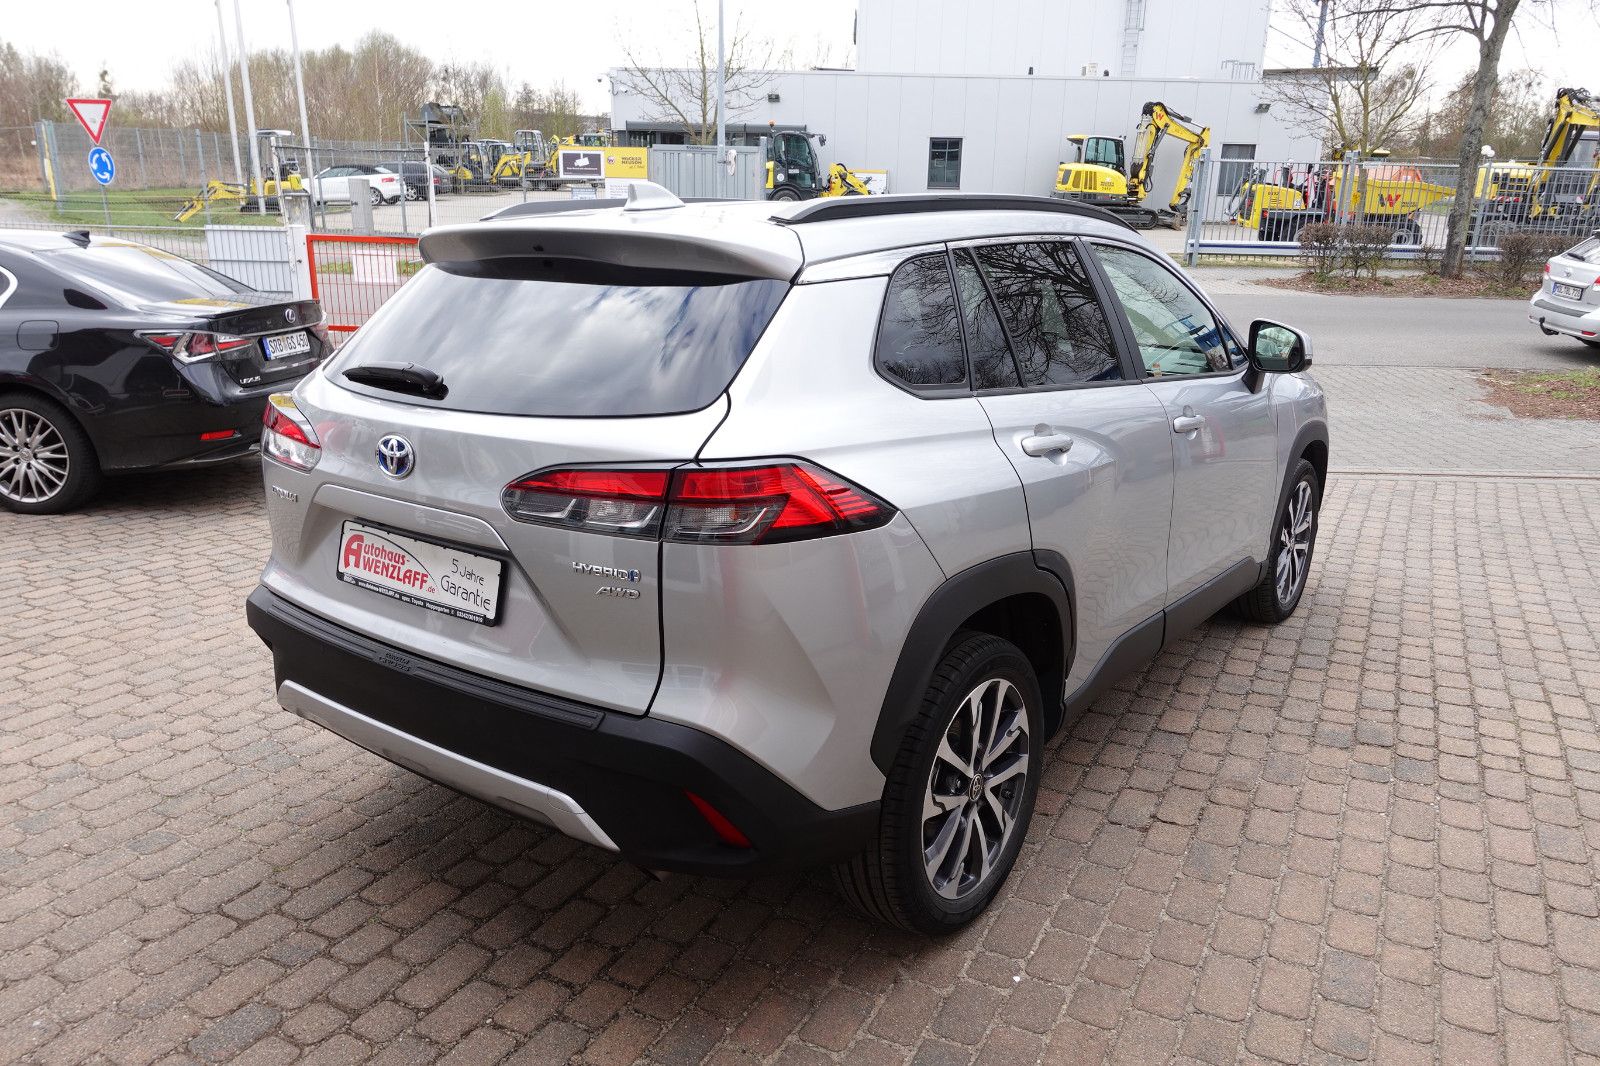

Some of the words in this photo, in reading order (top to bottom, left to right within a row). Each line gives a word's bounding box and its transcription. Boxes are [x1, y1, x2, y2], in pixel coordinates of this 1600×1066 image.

[269, 338, 283, 354] SRB
[286, 335, 297, 350] GS
[240, 376, 261, 384] LEXUS
[452, 558, 459, 574] 5
[460, 566, 485, 586] Jahre
[572, 561, 630, 580] HYBRID
[441, 575, 491, 611] Garantie
[595, 586, 641, 600] AWD
